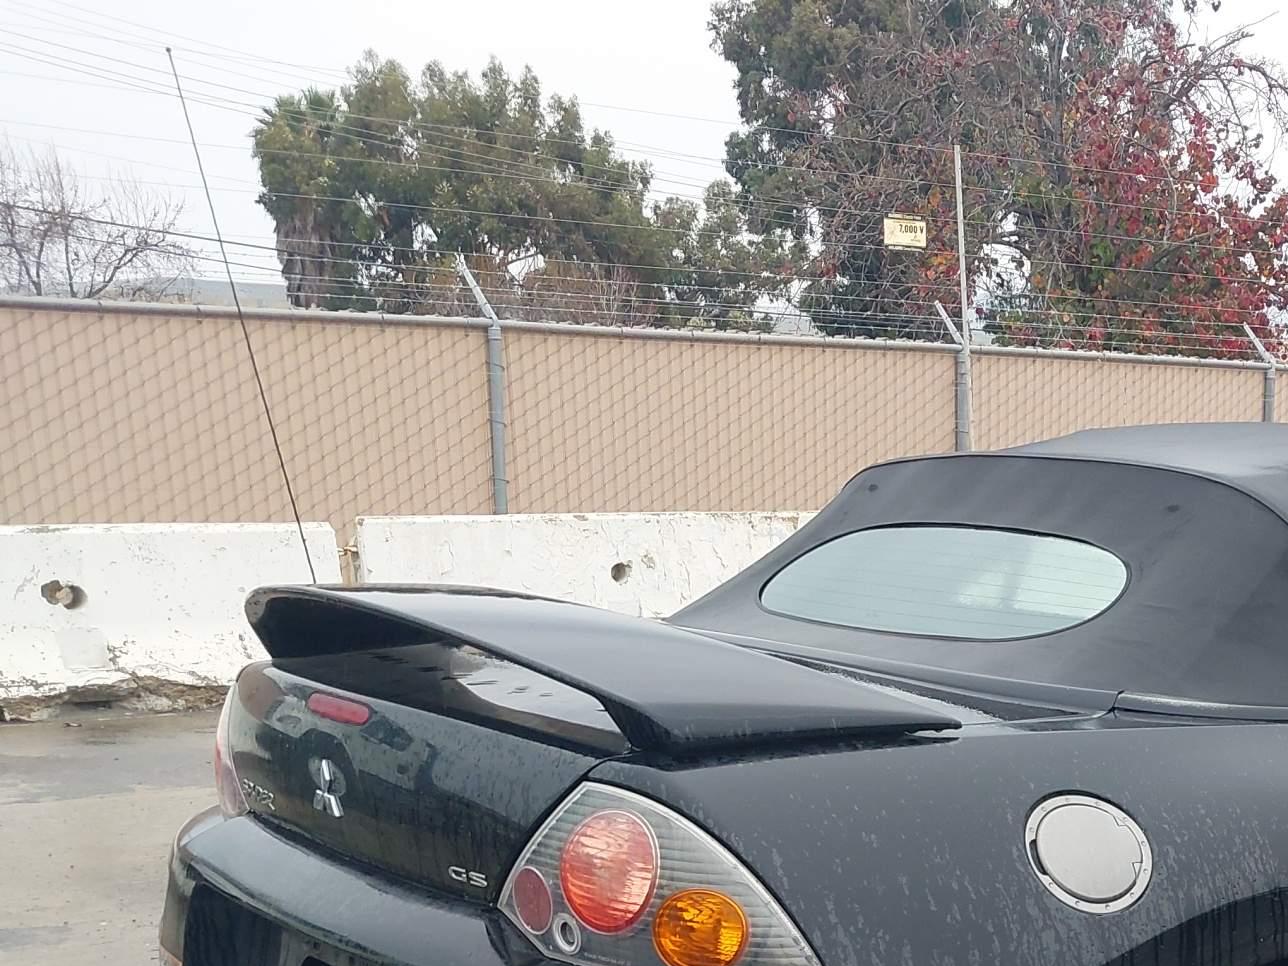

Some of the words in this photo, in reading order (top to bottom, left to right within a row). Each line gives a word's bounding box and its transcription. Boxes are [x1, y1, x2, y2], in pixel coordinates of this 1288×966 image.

[898, 223, 918, 234] 7,000
[919, 225, 924, 234] V
[448, 866, 488, 888] GS
